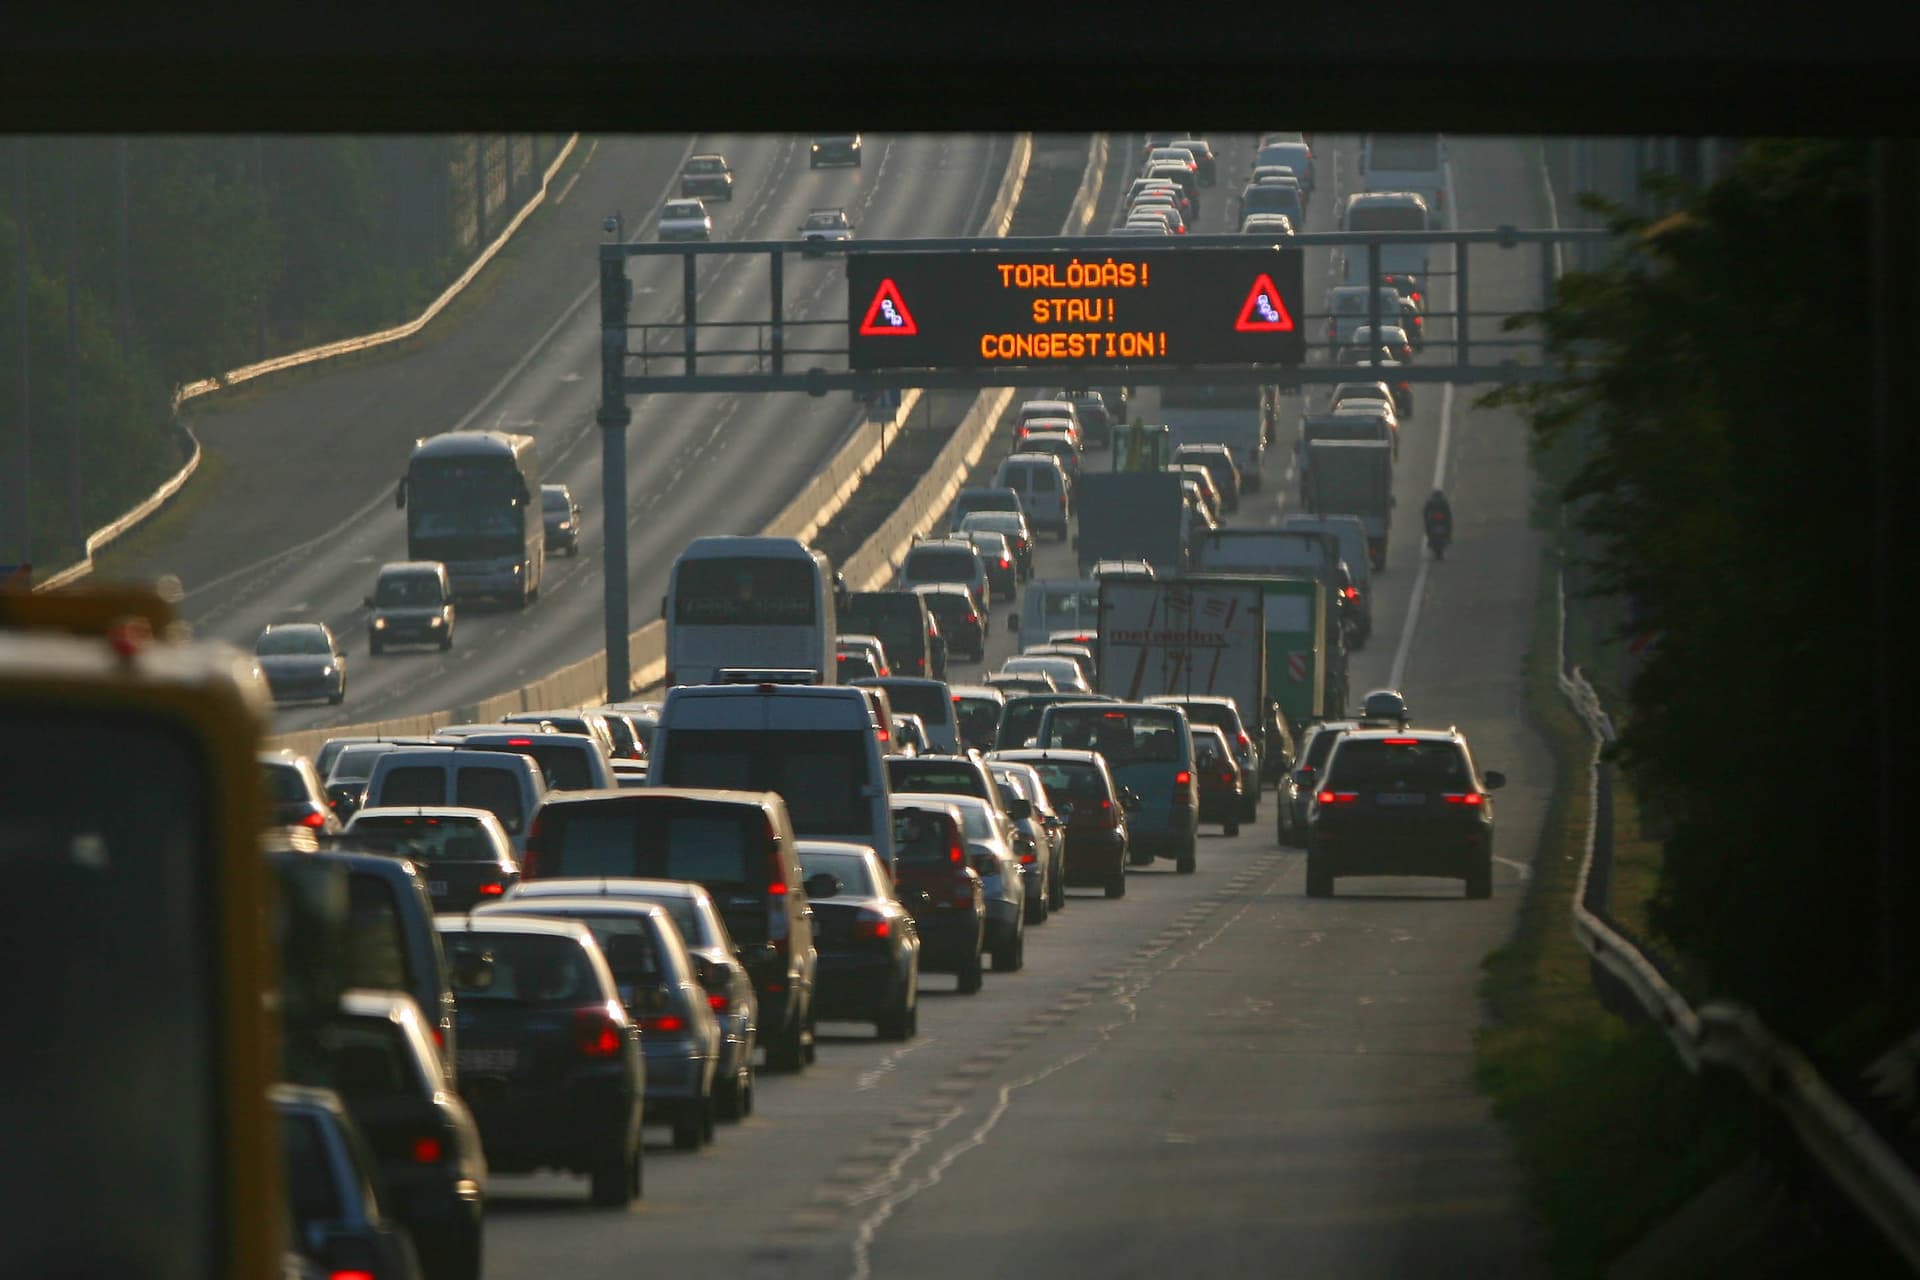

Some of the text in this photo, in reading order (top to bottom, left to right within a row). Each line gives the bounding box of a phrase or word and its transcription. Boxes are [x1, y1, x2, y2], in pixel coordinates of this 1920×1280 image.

[997, 257, 1149, 288] TORLÓDÁS!
[1032, 298, 1115, 323] STAU!
[980, 332, 1167, 359] CONGESTION!
